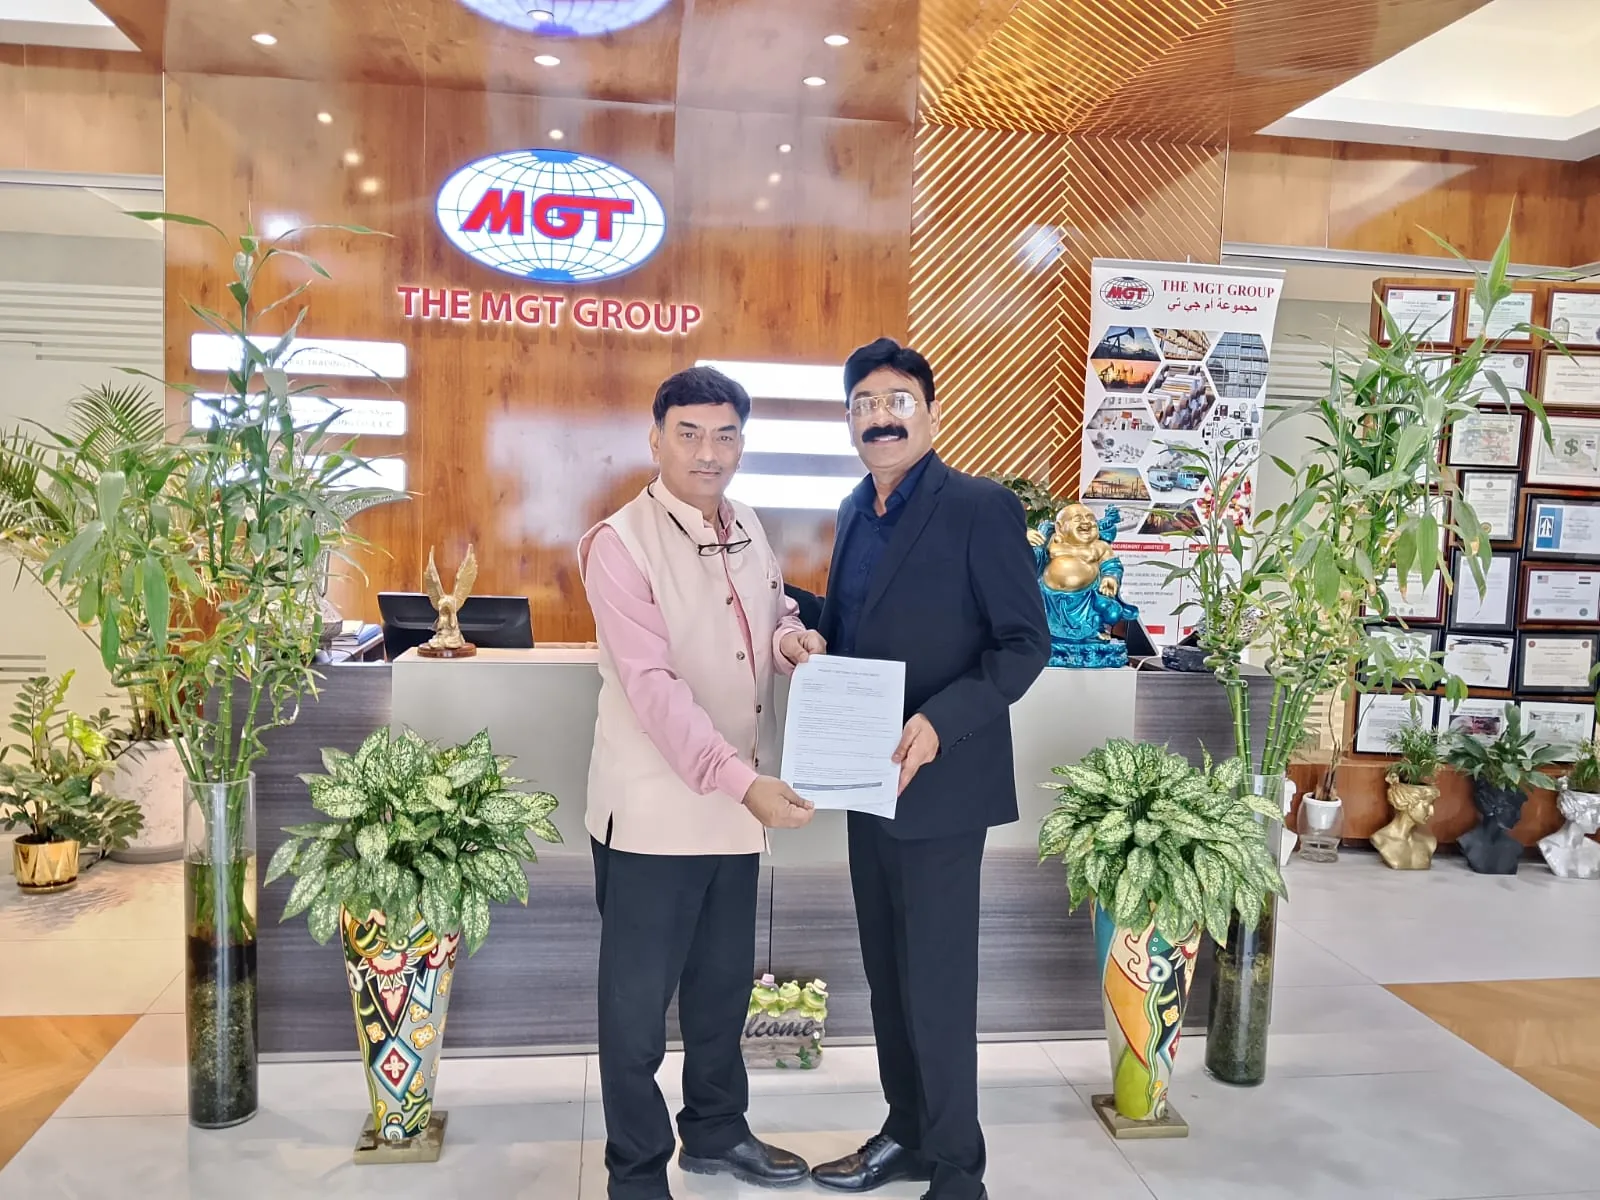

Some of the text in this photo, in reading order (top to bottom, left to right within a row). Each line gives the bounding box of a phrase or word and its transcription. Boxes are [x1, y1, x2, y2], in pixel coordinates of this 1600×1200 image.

[460, 189, 635, 241] MGT
[1105, 286, 1148, 301] MGT
[1161, 279, 1275, 299] THE MGT GROUP
[397, 286, 701, 334] THE MGT GROUP
[1217, 298, 1257, 314] مجموعة
[744, 1012, 823, 1039] lcome
